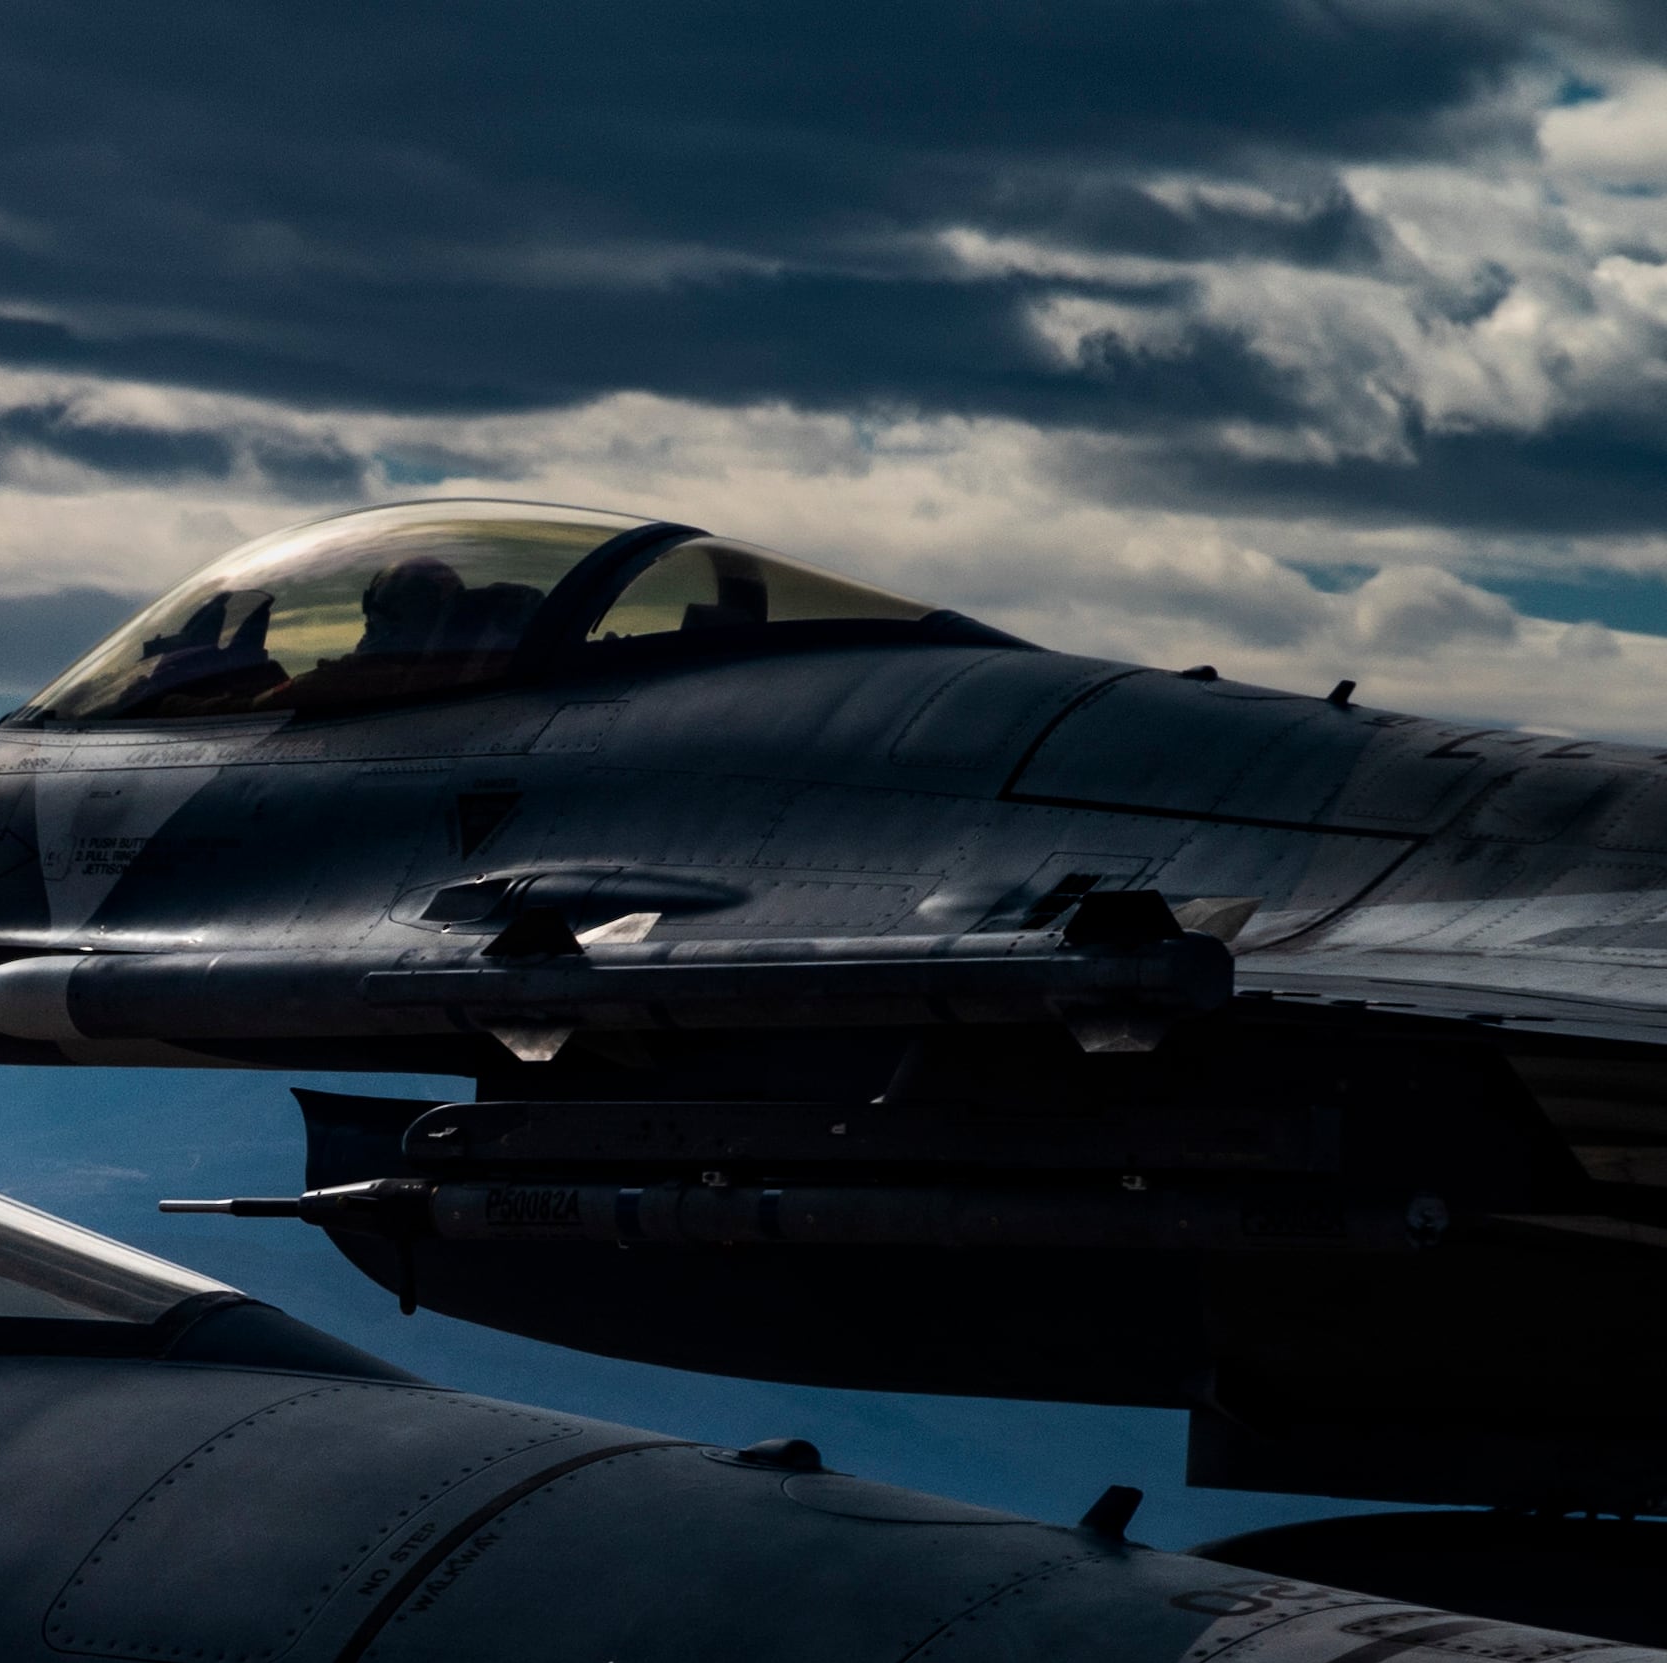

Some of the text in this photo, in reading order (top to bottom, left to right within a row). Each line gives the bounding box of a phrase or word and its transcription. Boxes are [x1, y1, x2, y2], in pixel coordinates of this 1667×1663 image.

[85, 851, 108, 862] PULL
[89, 838, 116, 849] PUSH
[357, 1522, 436, 1596] NO STEP
[409, 1531, 501, 1613] WALKWAY
